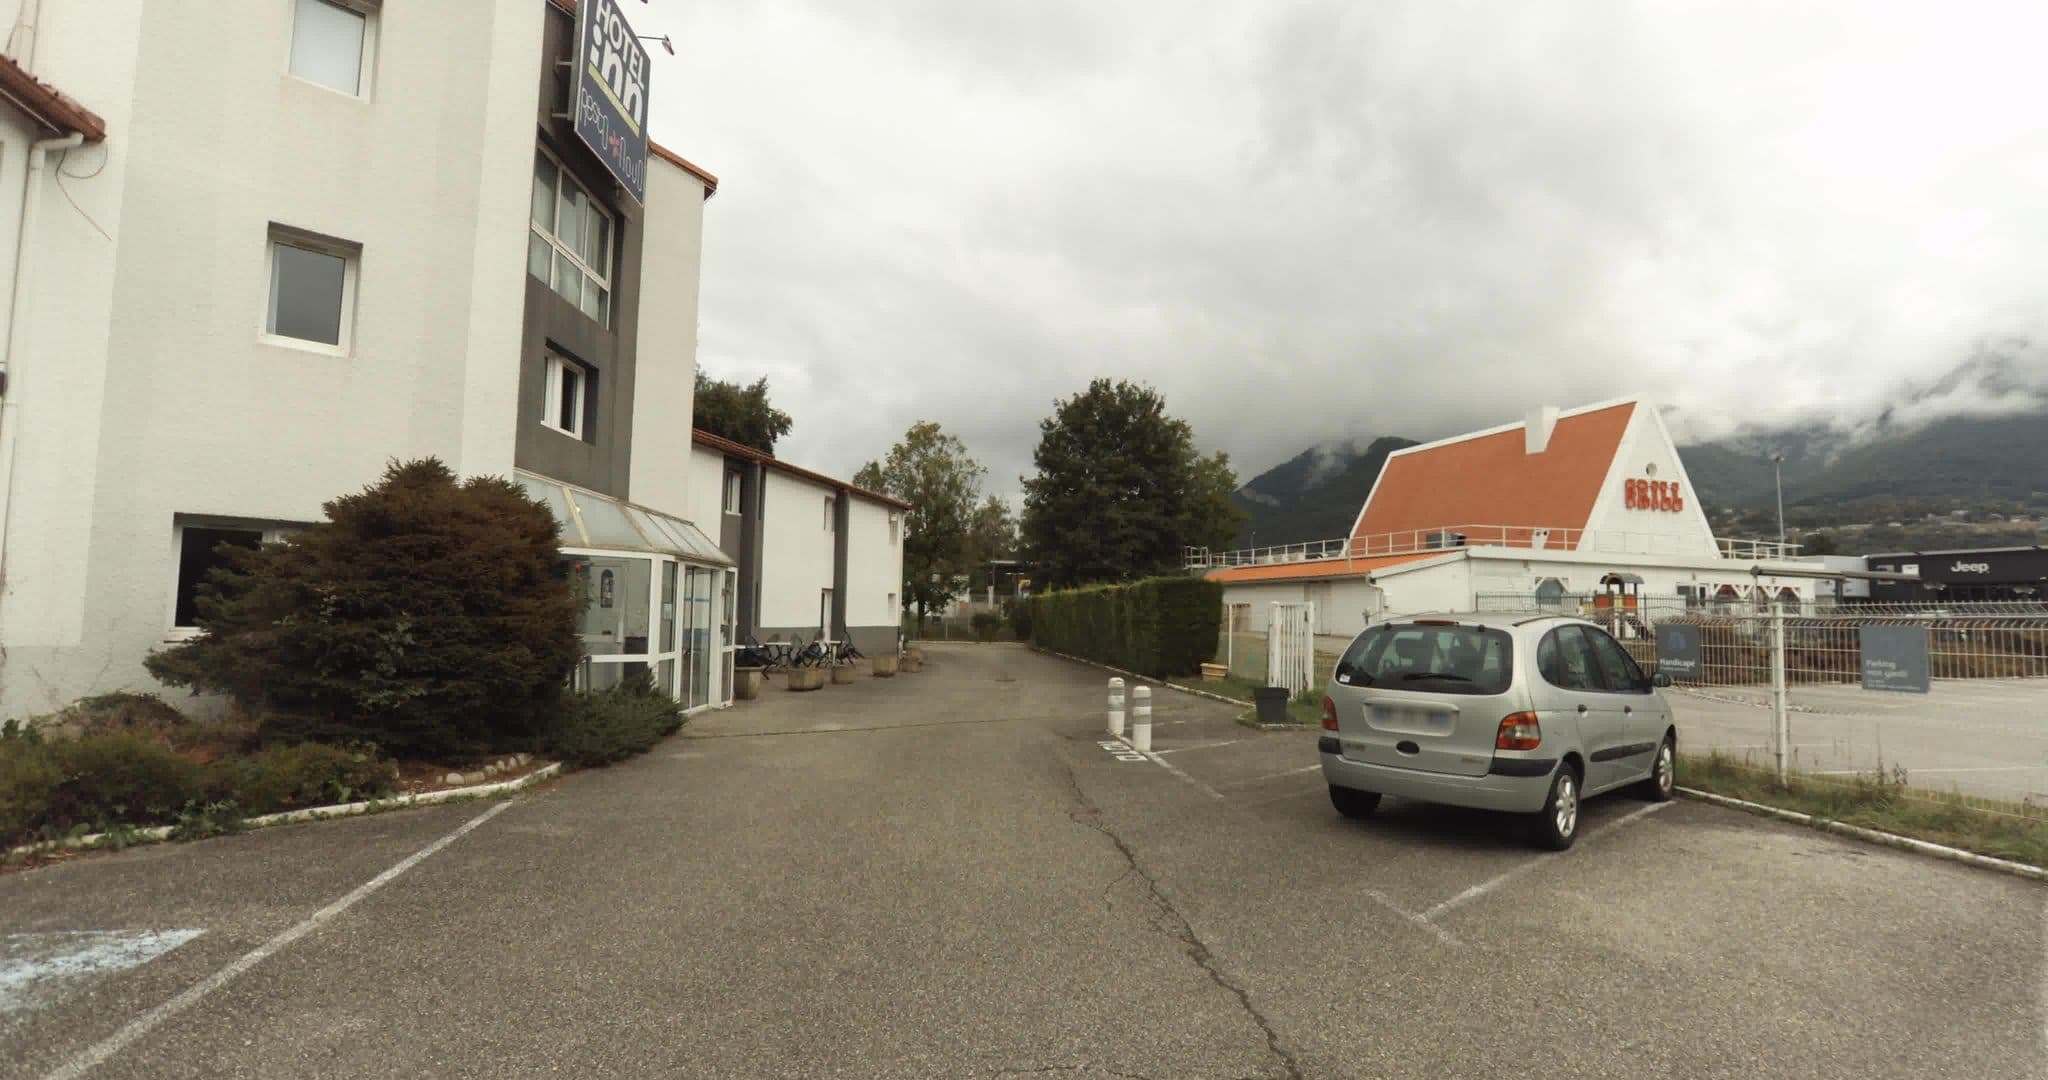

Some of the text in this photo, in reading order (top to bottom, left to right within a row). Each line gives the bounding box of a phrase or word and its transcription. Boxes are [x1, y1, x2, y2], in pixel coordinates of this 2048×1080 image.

[590, 23, 643, 126] inn
[596, 0, 645, 90] HOTEL
[1951, 561, 1988, 574] Jeep
